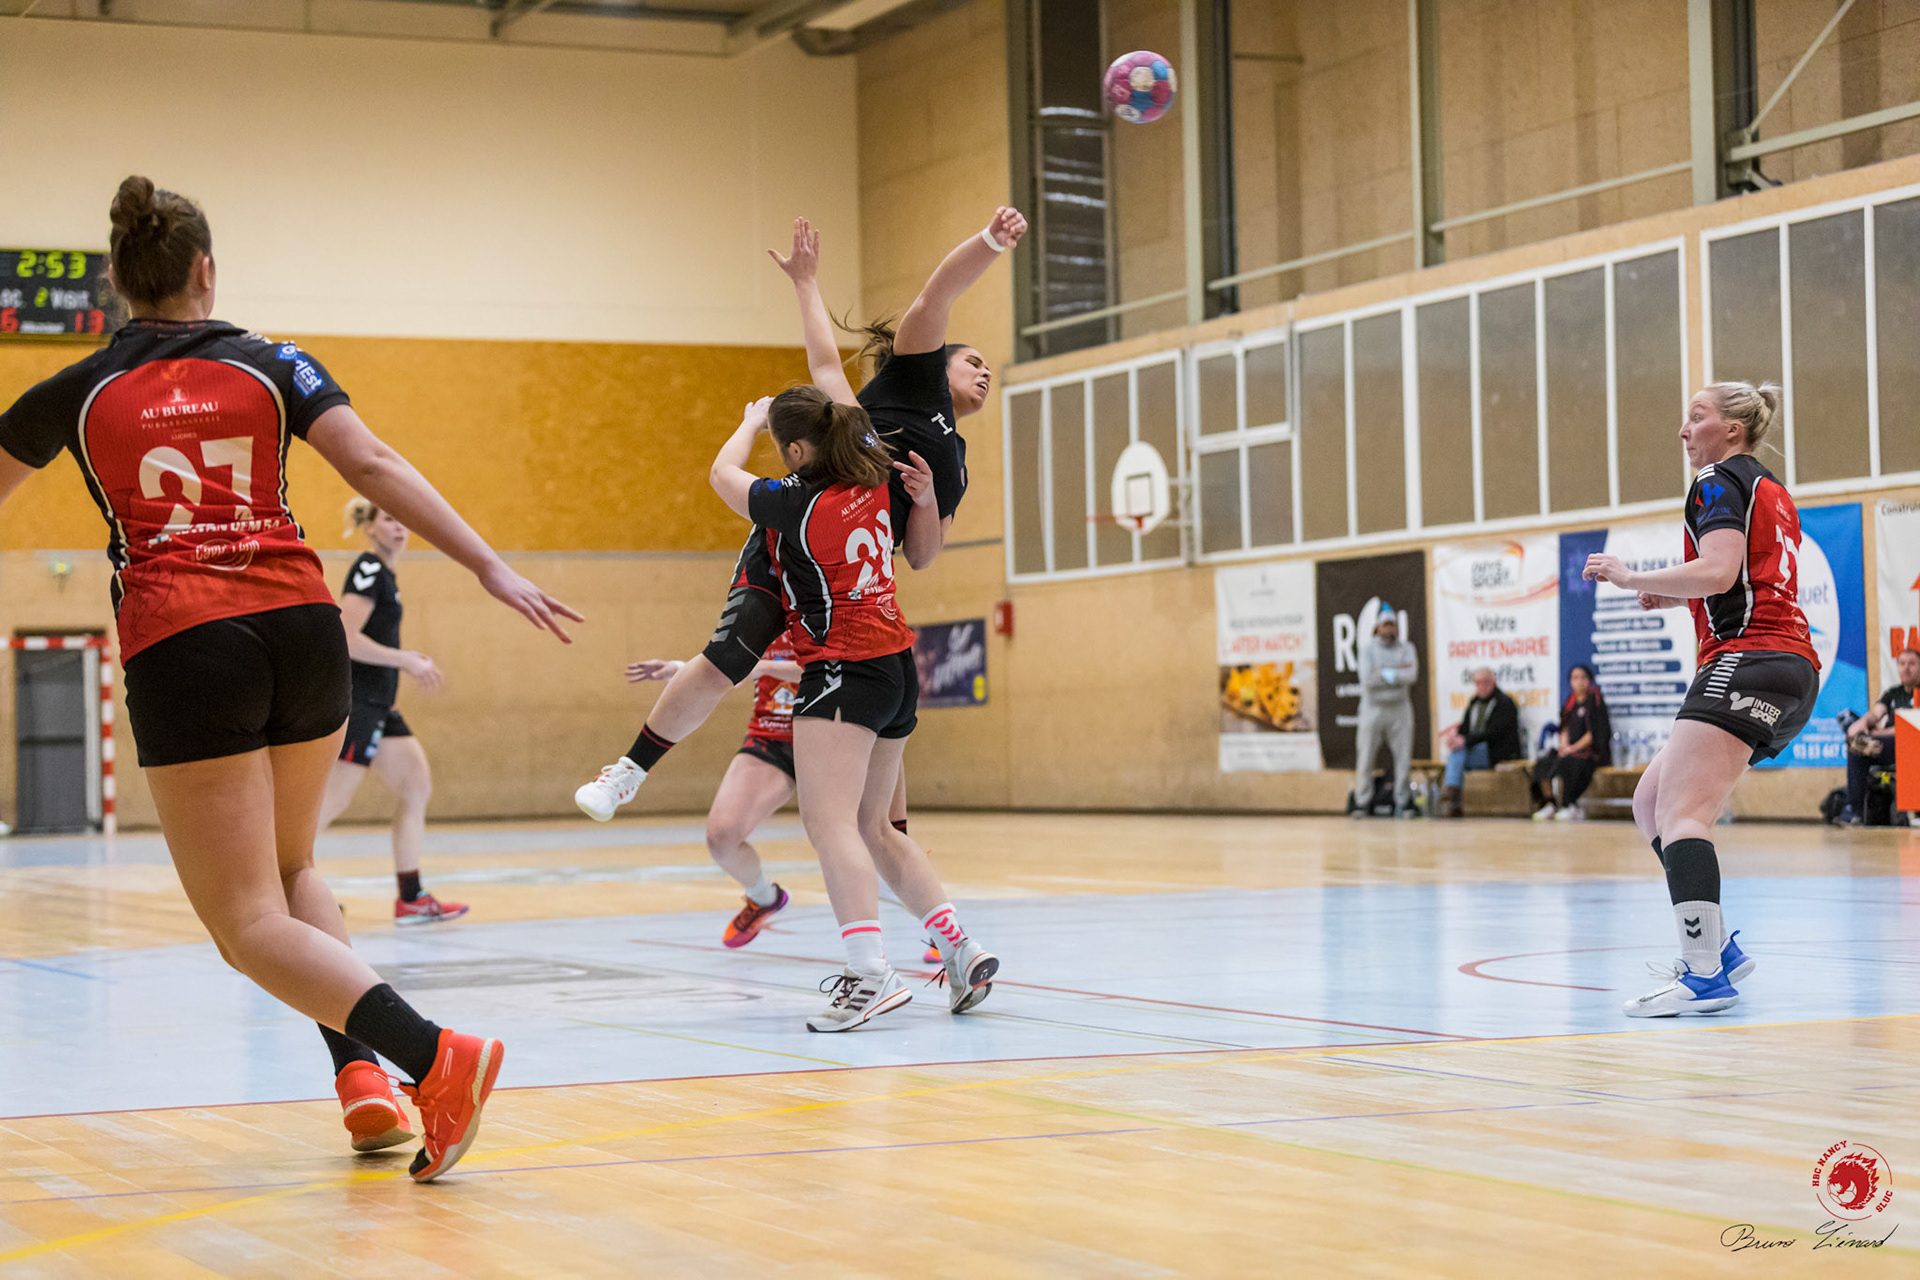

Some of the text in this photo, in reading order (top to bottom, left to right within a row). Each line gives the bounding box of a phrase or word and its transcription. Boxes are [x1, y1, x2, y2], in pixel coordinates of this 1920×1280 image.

[17, 249, 87, 279] 2:53
[75, 308, 104, 334] 13
[140, 401, 219, 420] AU BUREAU
[930, 412, 954, 436] 14
[138, 436, 254, 535] 27
[850, 489, 874, 511] BUREAU
[1476, 614, 1517, 633] Votre
[1447, 636, 1550, 659] PARTENAIRE
[1749, 707, 1777, 727] SPORT
[1753, 698, 1781, 719] INTER
